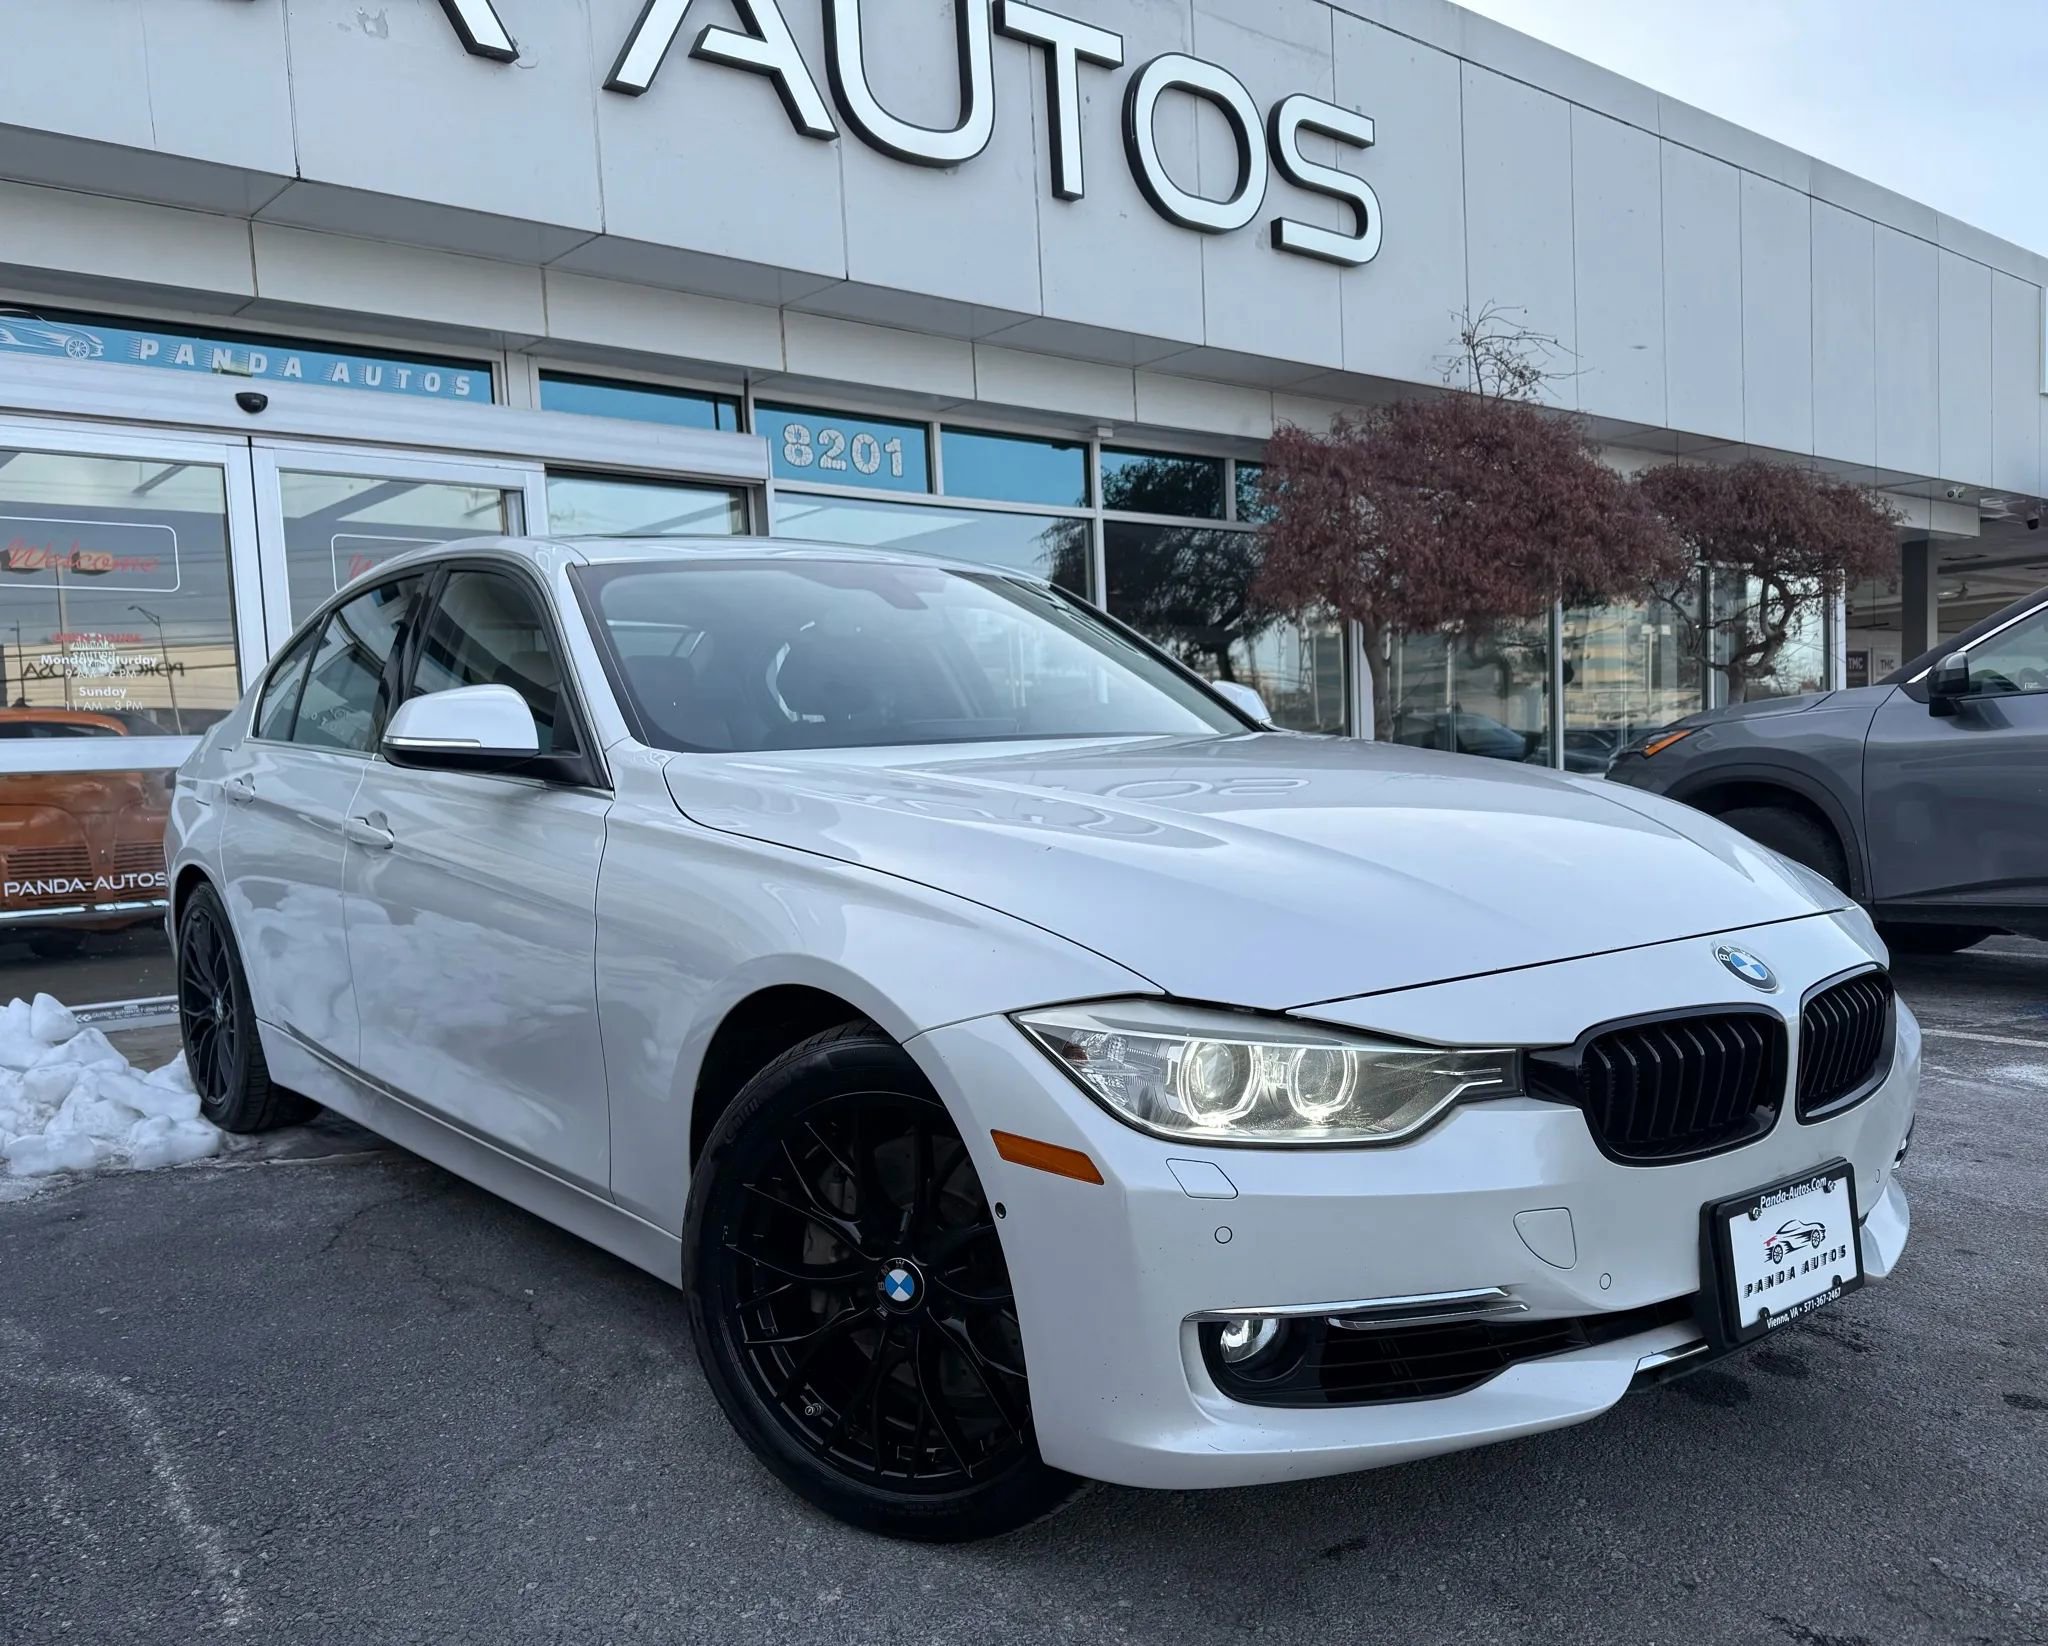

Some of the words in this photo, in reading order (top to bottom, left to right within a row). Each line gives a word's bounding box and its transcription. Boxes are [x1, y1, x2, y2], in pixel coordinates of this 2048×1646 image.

[605, 0, 1383, 266] AUTOS
[136, 337, 303, 379] PANDA
[329, 362, 471, 397] AUTOS
[783, 423, 903, 478] 8201
[8, 537, 160, 573] Welcome
[77, 669, 96, 680] AM
[120, 669, 138, 680] PM
[79, 686, 127, 699] Sunday
[65, 701, 78, 712] 11
[83, 701, 103, 711] AM
[115, 700, 122, 711] 3
[126, 700, 144, 711] PM
[3, 872, 168, 898] PANDA-AUTOS
[1760, 1176, 1828, 1209] Panda-Autos.Com
[1744, 1266, 1797, 1298] PANDA
[1800, 1245, 1847, 1275] AUTOS
[1766, 1313, 1790, 1329] Vienna,
[1789, 1307, 1800, 1319] VA
[1803, 1286, 1842, 1313] 571-367-2467
